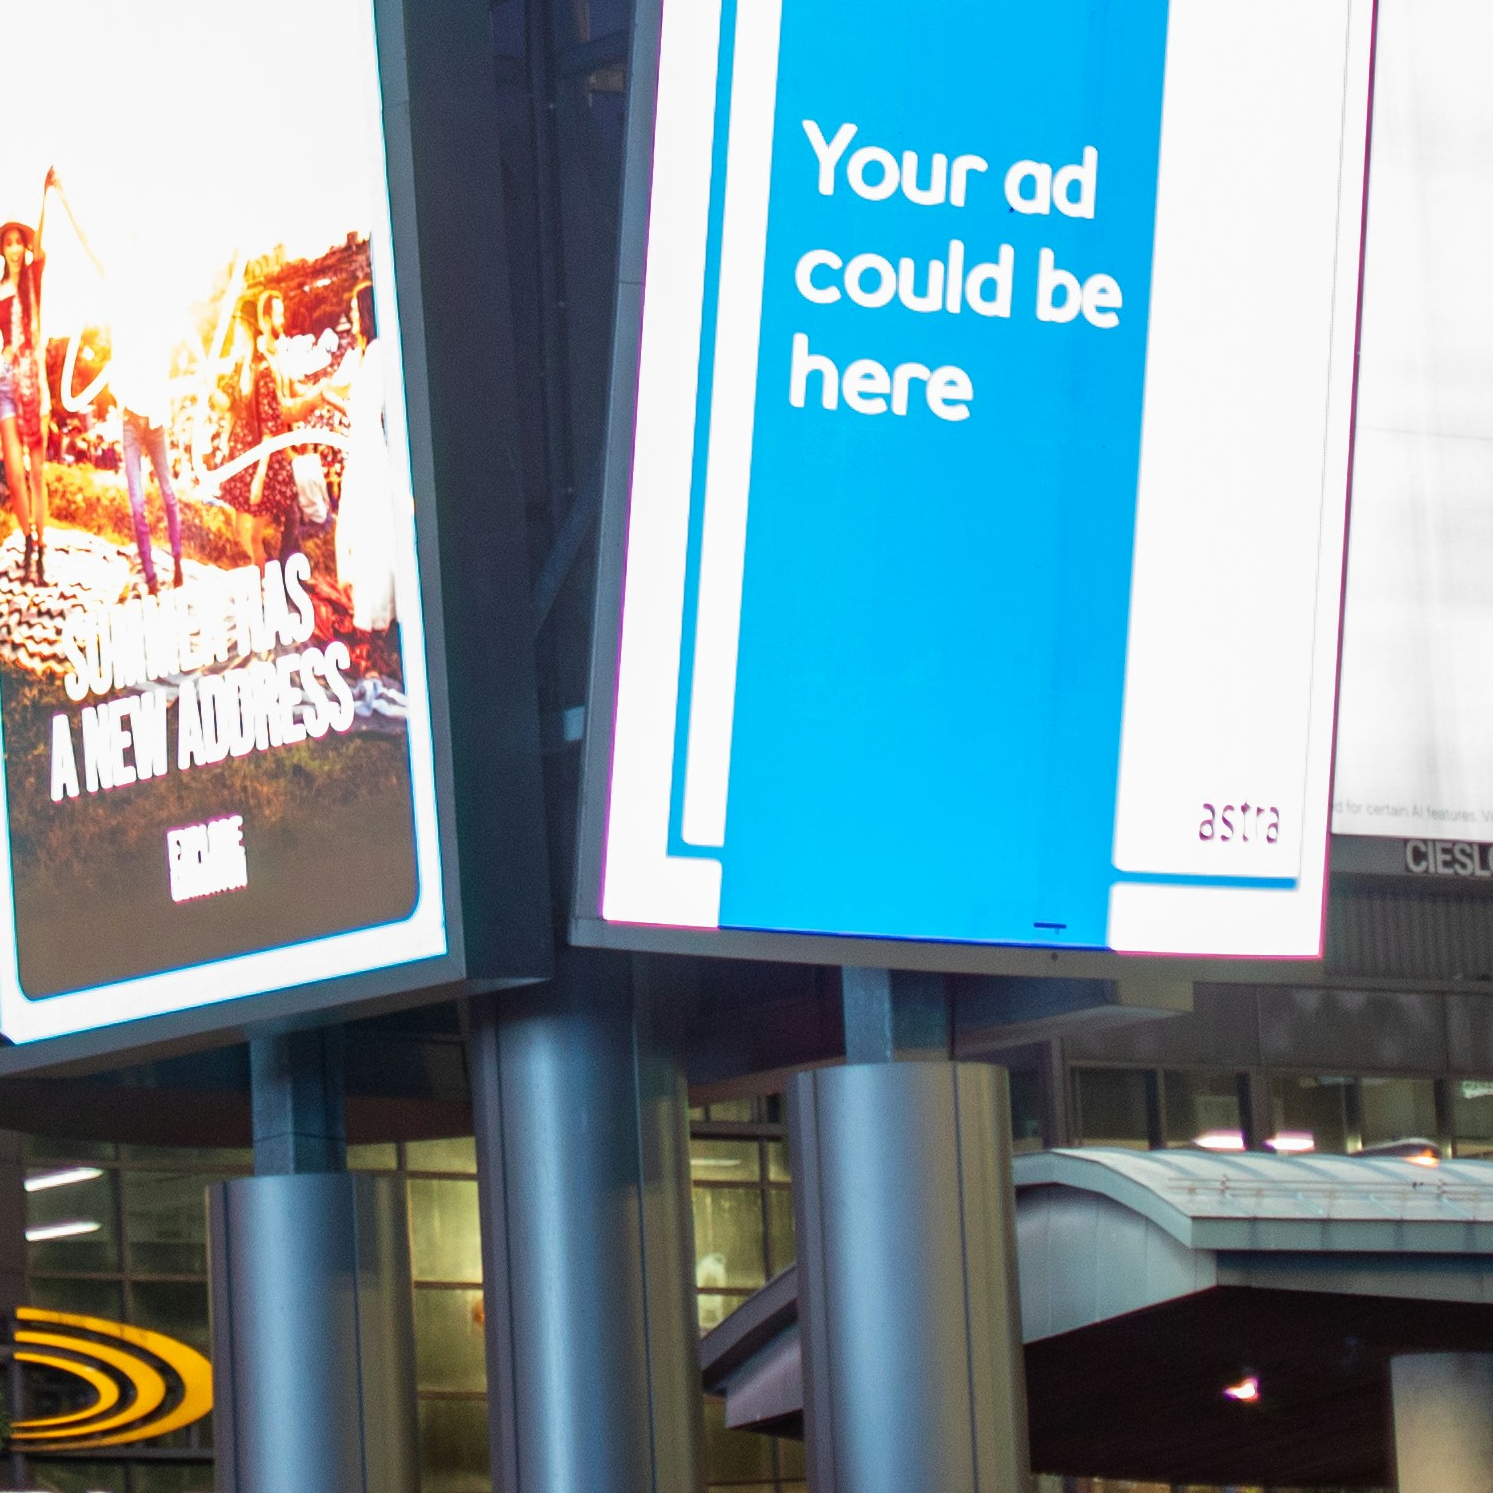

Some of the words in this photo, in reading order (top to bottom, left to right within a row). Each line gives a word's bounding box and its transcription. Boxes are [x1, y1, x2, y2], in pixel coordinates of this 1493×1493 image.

[801, 119, 989, 209] Your
[1003, 145, 1099, 220] ad
[794, 239, 1015, 320] could
[1035, 248, 1124, 330] be
[788, 332, 975, 422] here
[50, 712, 81, 802] A
[81, 690, 168, 793] NEW
[177, 639, 355, 771] ADDRESS
[1198, 799, 1281, 844] astra
